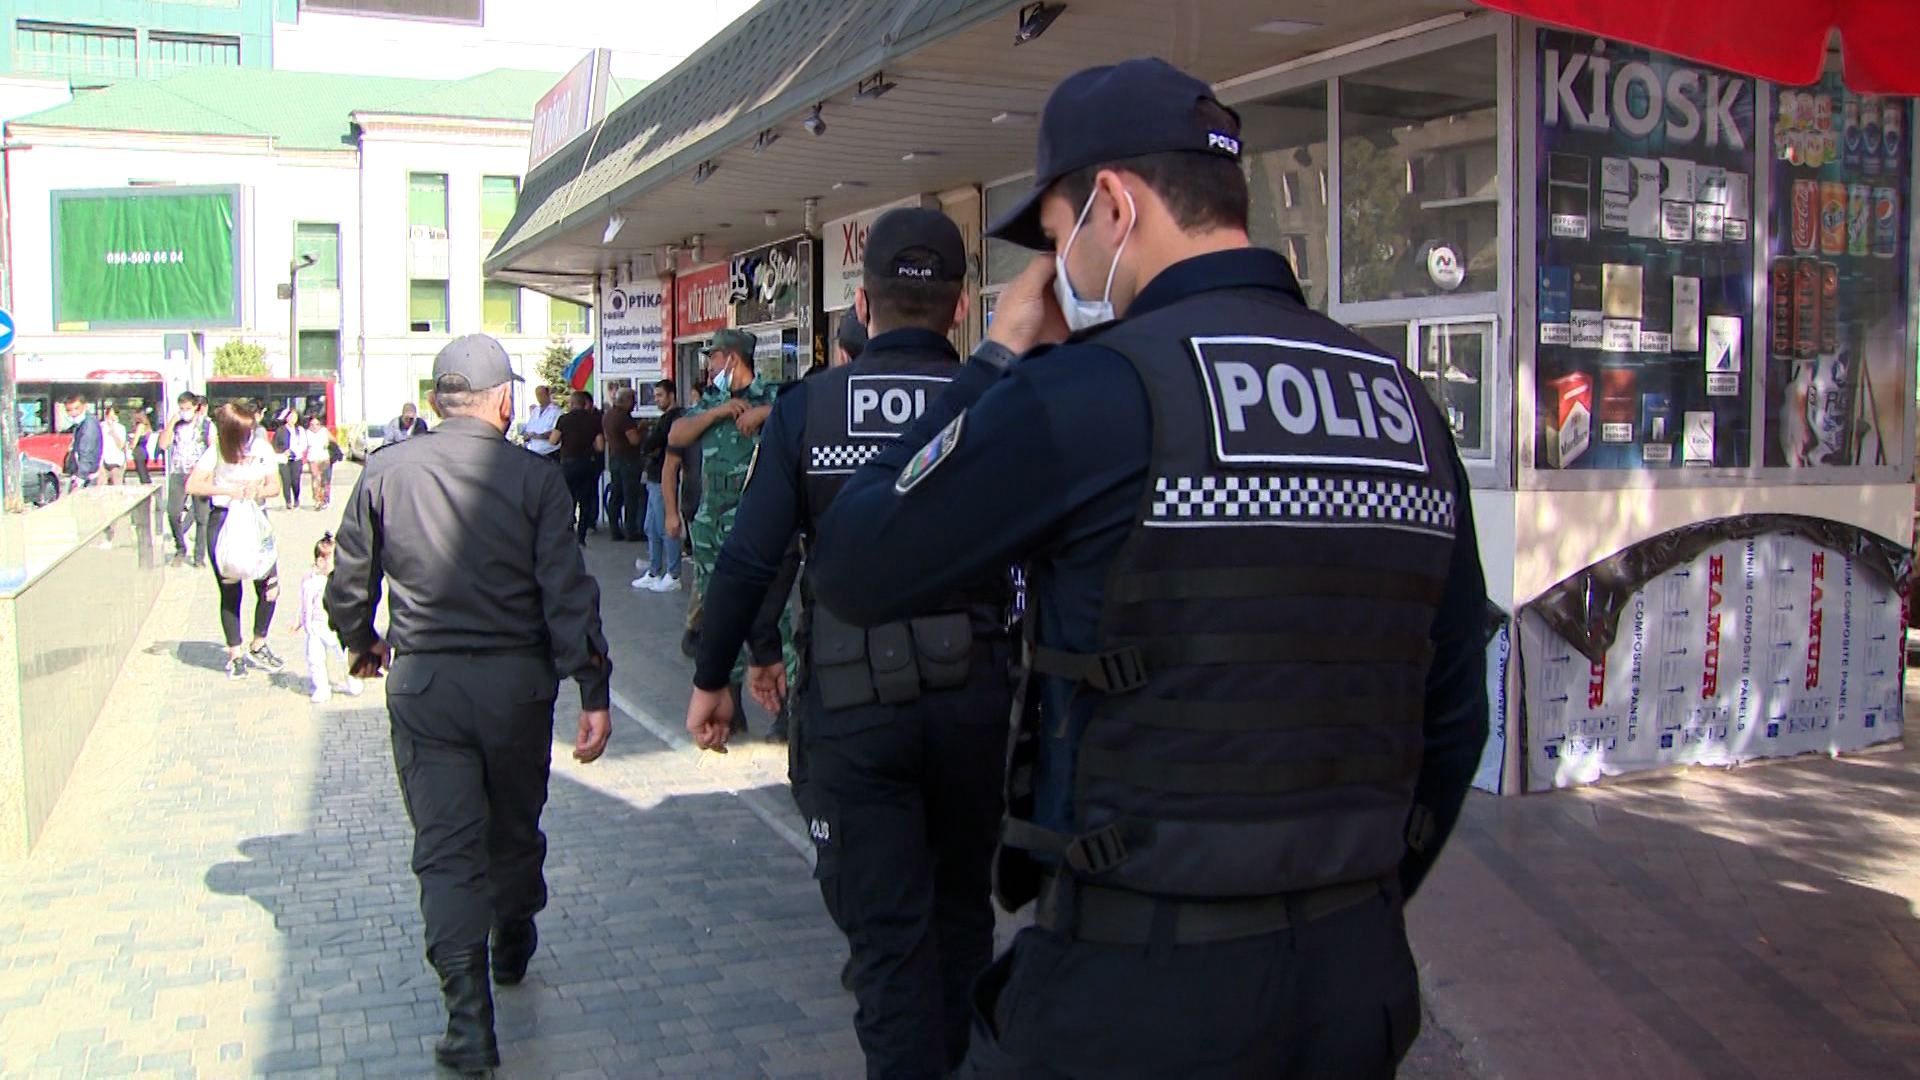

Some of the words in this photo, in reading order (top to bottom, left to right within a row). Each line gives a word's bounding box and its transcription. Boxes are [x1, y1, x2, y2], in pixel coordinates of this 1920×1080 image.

[853, 388, 925, 424] POL
[1744, 540, 1755, 590] MINIUM
[1631, 601, 1646, 685] COMPOSITE
[1702, 554, 1724, 701] HAMUR
[1741, 595, 1754, 675] COMPOSITE
[1805, 551, 1824, 692] HAMUR
[1840, 591, 1852, 668] COMPOSITE
[1627, 686, 1641, 742] PANELS
[1736, 678, 1750, 732] PANELS
[1837, 671, 1850, 722] PANELS
